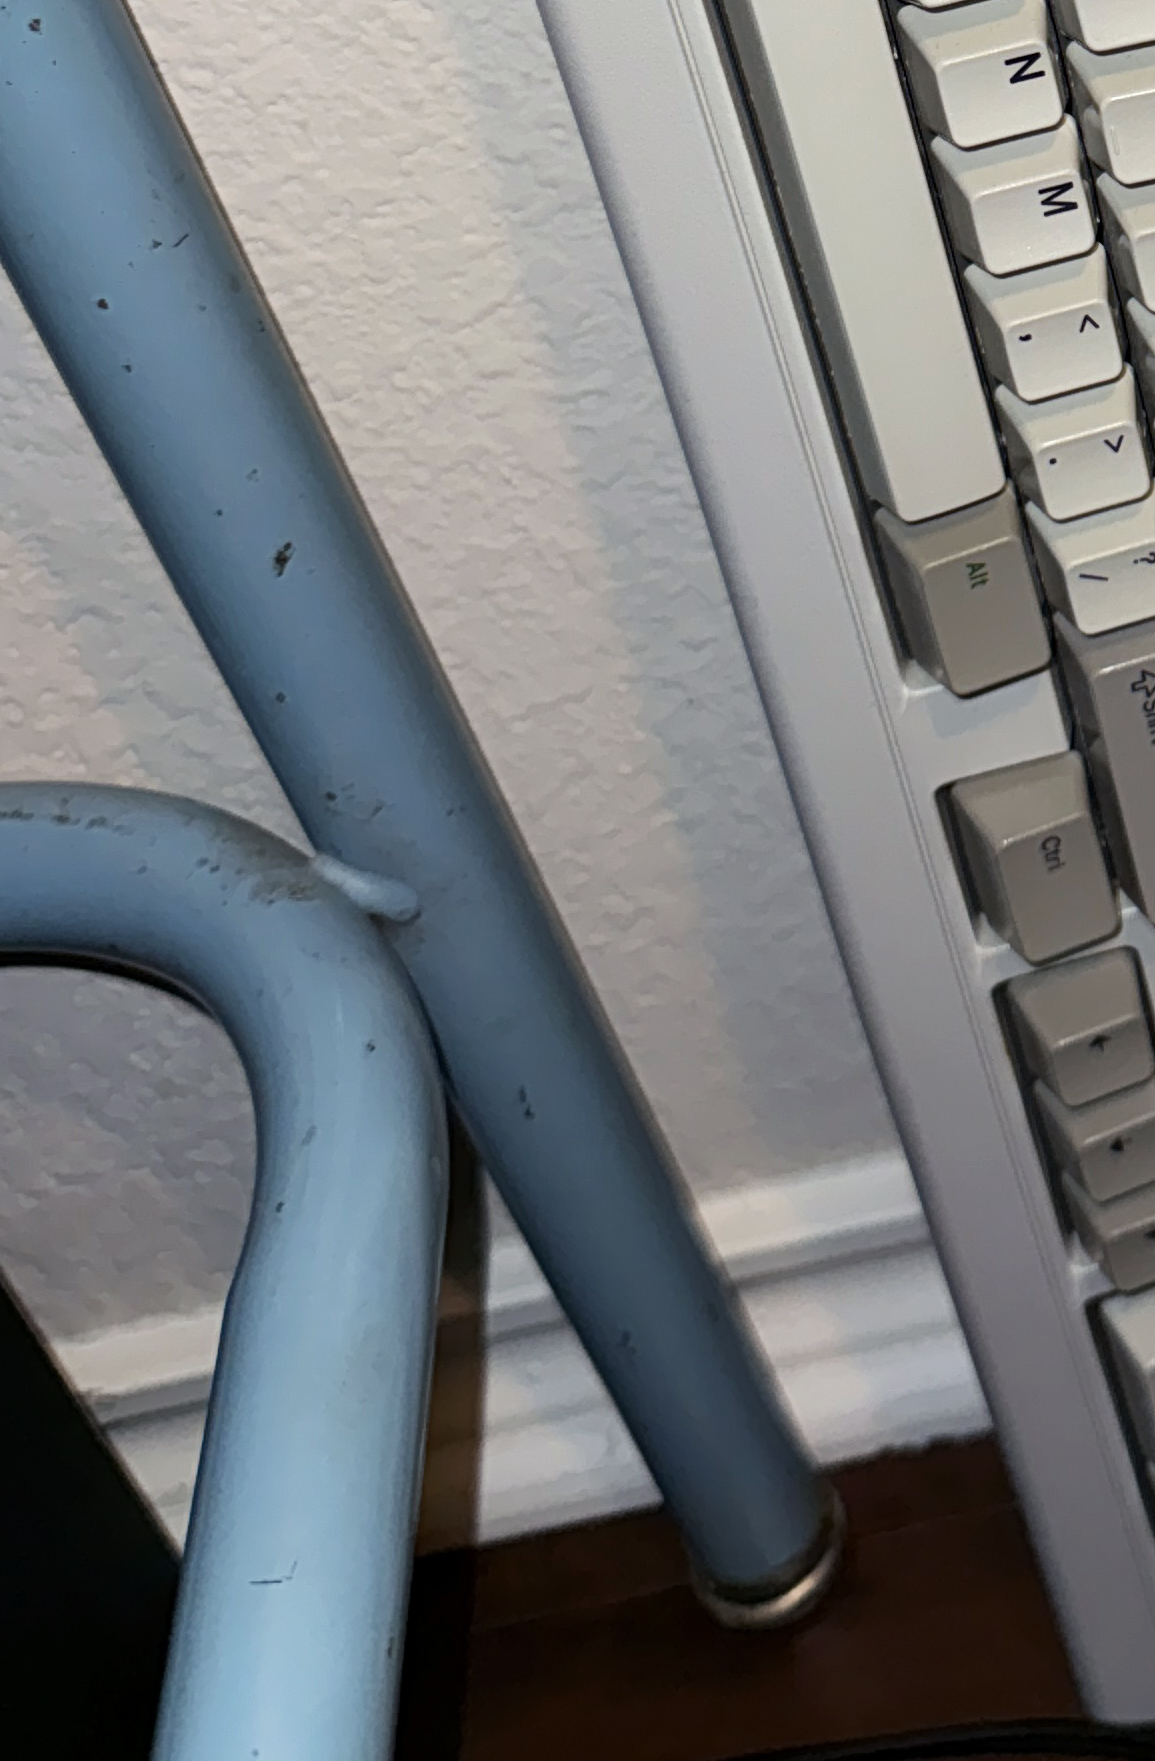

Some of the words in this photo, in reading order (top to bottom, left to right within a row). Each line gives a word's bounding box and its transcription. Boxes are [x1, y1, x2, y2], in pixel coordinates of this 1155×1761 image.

[1004, 51, 1046, 84] N
[1038, 181, 1079, 217] M
[966, 562, 991, 589] Alt
[1041, 835, 1066, 873] Ctrl
